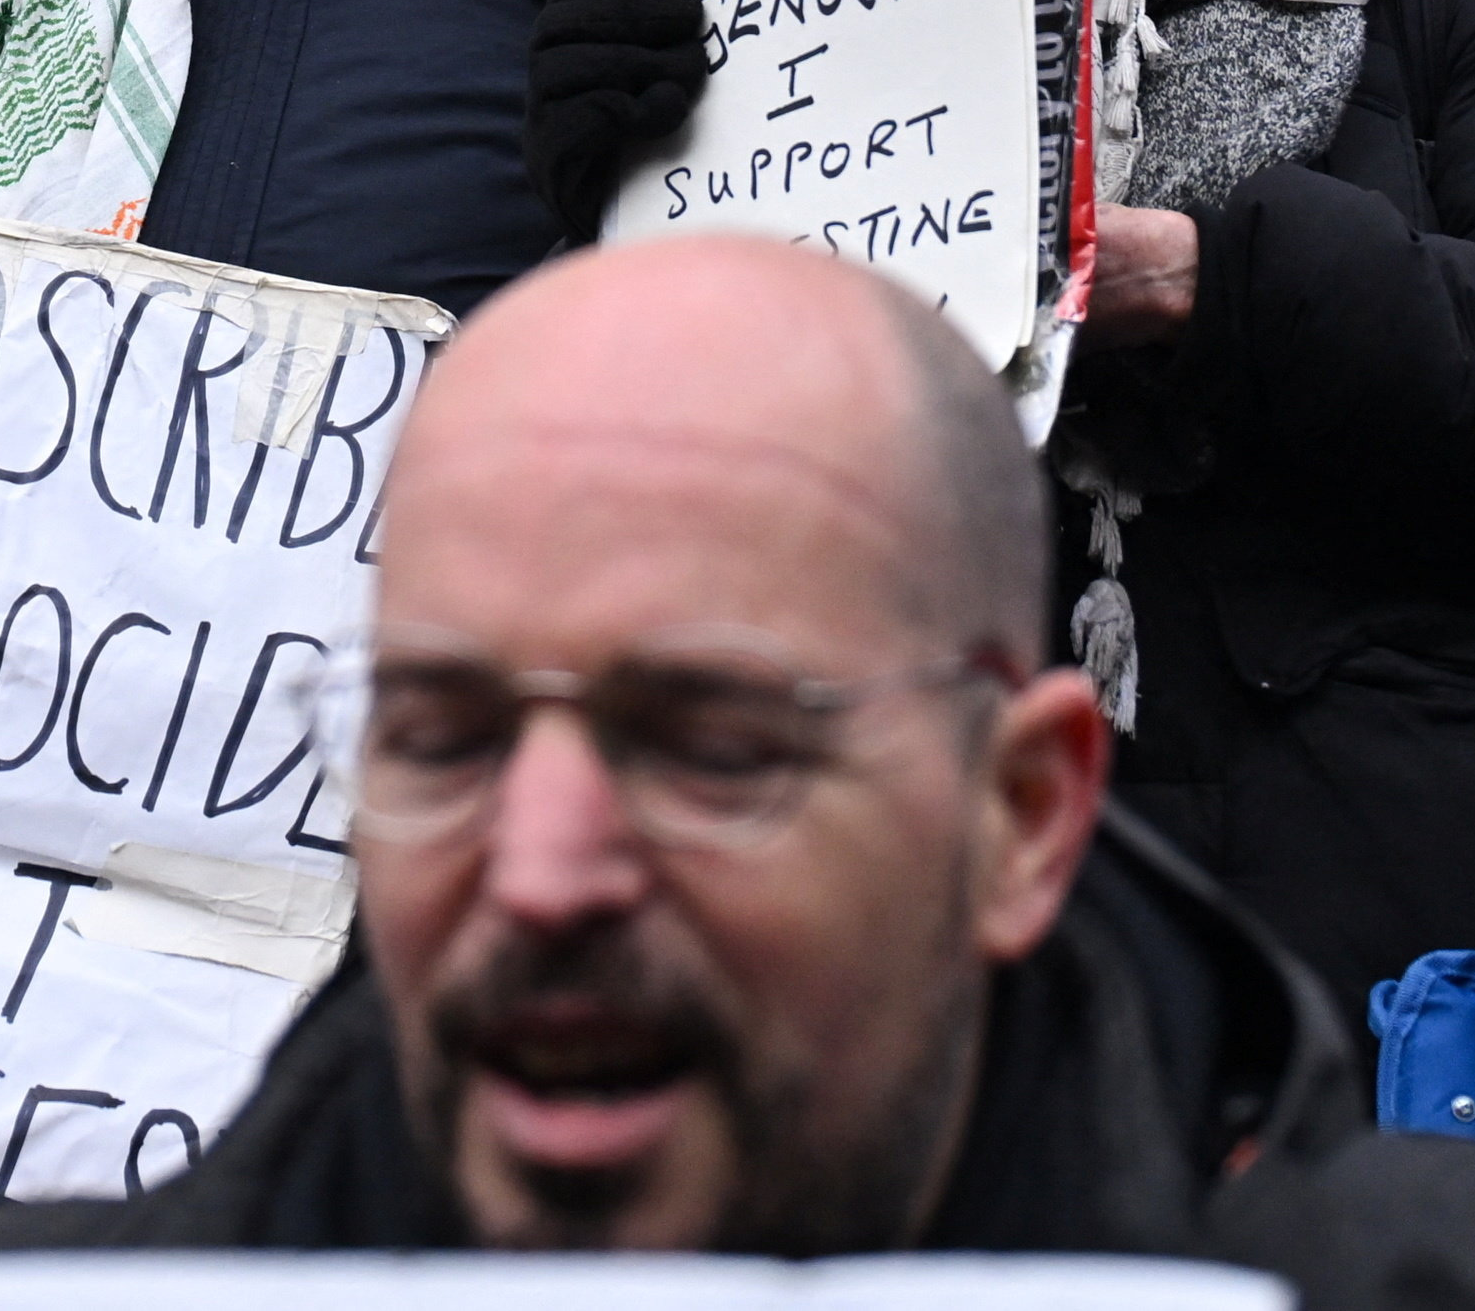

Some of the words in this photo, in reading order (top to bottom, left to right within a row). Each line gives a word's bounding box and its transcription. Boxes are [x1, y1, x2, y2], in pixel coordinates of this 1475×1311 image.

[767, 44, 828, 120] I
[664, 105, 948, 219] SUPPORT
[789, 190, 993, 262] STINE
